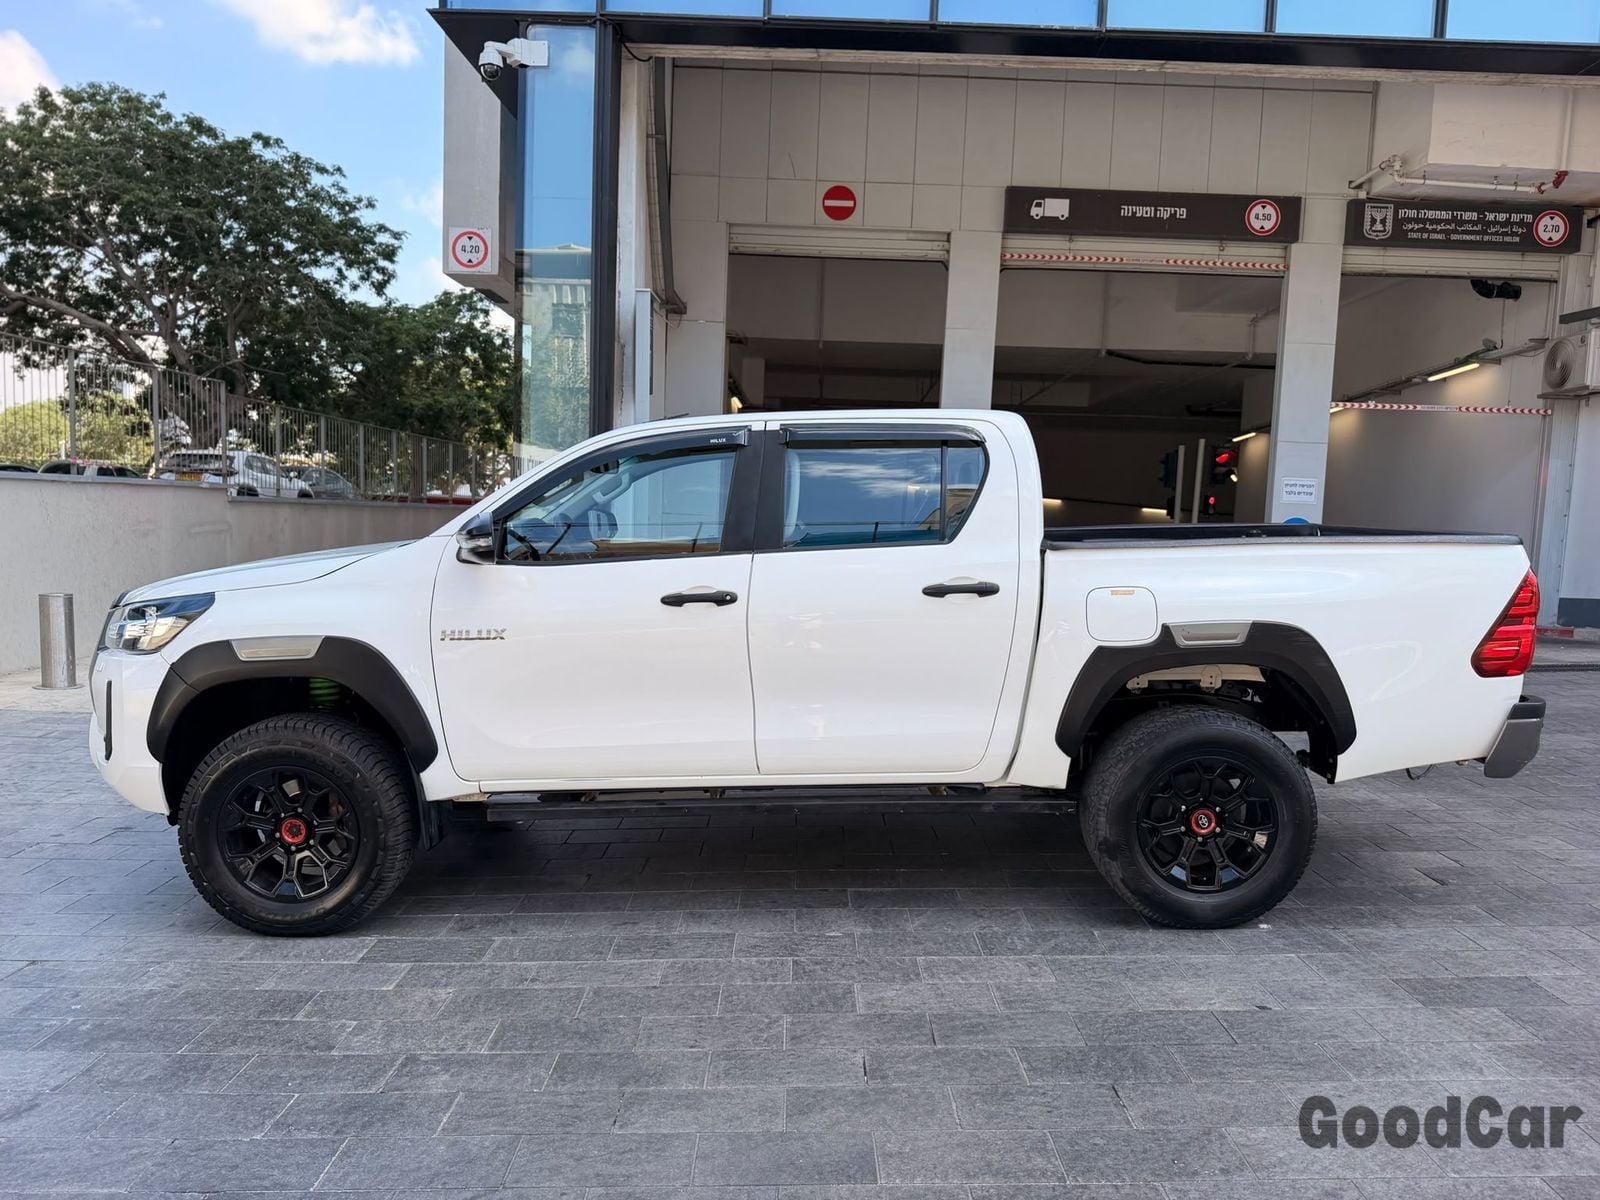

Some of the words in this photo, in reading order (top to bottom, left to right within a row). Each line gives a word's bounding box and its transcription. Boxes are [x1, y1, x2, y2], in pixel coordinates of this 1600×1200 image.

[1120, 205, 1155, 218] וטעינה
[1156, 206, 1187, 220] פריקה
[1398, 208, 1418, 219] חולון
[1418, 208, 1452, 220] הממשלה
[1453, 210, 1478, 221] משרדי
[1484, 211, 1510, 222] ישראל
[1254, 213, 1272, 222] 4.50
[1510, 213, 1533, 222] מדינת
[1543, 224, 1560, 234] 2.70
[1407, 232, 1422, 240] STATE
[1429, 232, 1447, 240] ISRAEL
[1450, 233, 1483, 242] GOVERNMENT
[1483, 234, 1503, 242] OFFICES
[461, 244, 480, 254] 4.20
[440, 628, 507, 641] HILUX
